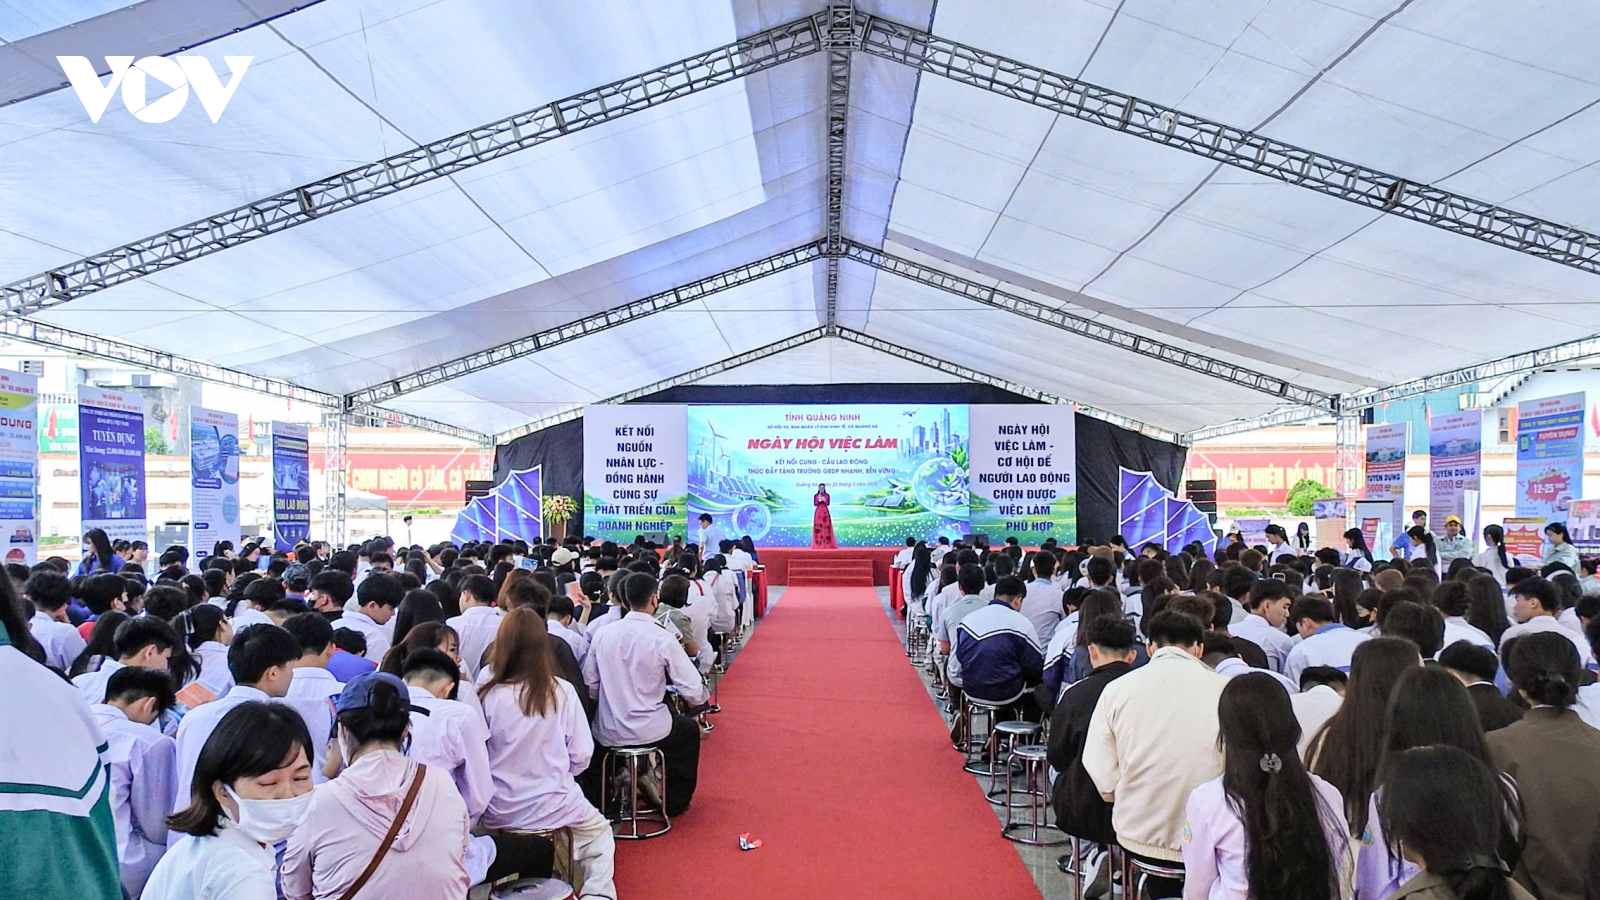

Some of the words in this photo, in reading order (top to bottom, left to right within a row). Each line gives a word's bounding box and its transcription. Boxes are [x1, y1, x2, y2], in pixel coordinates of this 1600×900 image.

[785, 412, 803, 421] TỈNH
[806, 412, 837, 421] QUẢNG
[615, 424, 635, 436] KẾT
[637, 424, 654, 436] NỐI
[998, 424, 1028, 435] NGÀY
[1031, 424, 1050, 437] HỘI
[92, 428, 116, 442] TUYỂN
[117, 432, 135, 446] DỤNG
[617, 440, 652, 452] NGUỒN
[748, 436, 793, 449] NGÀY
[795, 436, 825, 452] HỘI
[829, 436, 862, 452] VIỆC
[865, 436, 898, 449] LÀM
[994, 440, 1019, 453] VIỆC
[1023, 440, 1046, 450] LÀM
[606, 456, 635, 468] NHÂN
[638, 457, 657, 470] LỰC
[997, 456, 1013, 467] CƠ
[1016, 456, 1034, 469] HỘI
[1038, 453, 1052, 467] ĐỂ
[410, 465, 423, 490] CÓ
[450, 464, 462, 490] CÓ
[605, 470, 634, 484] ĐỒNG
[637, 472, 664, 484] HÀNH
[979, 472, 1013, 483] NGƯỜI
[1016, 474, 1036, 483] LAO
[1040, 472, 1070, 485] ĐỘNG
[1251, 463, 1284, 494] NHIỆM
[1433, 480, 1453, 490] 5000
[1534, 483, 1554, 494] 12-25
[613, 488, 640, 500] CÙNG
[644, 488, 658, 501] SỰ
[993, 490, 1023, 501] CHỌN
[1026, 489, 1056, 501] ĐƯỢC
[595, 504, 620, 515] PHÁT
[623, 502, 652, 515] TRIỂN
[656, 503, 676, 515] CỦA
[999, 504, 1023, 517] VIỆC
[1027, 504, 1050, 515] LÀM
[598, 521, 632, 531] DOANH
[636, 520, 673, 532] NGHIỆP
[1006, 520, 1028, 532] PHÙ
[1032, 521, 1054, 533] HỢP
